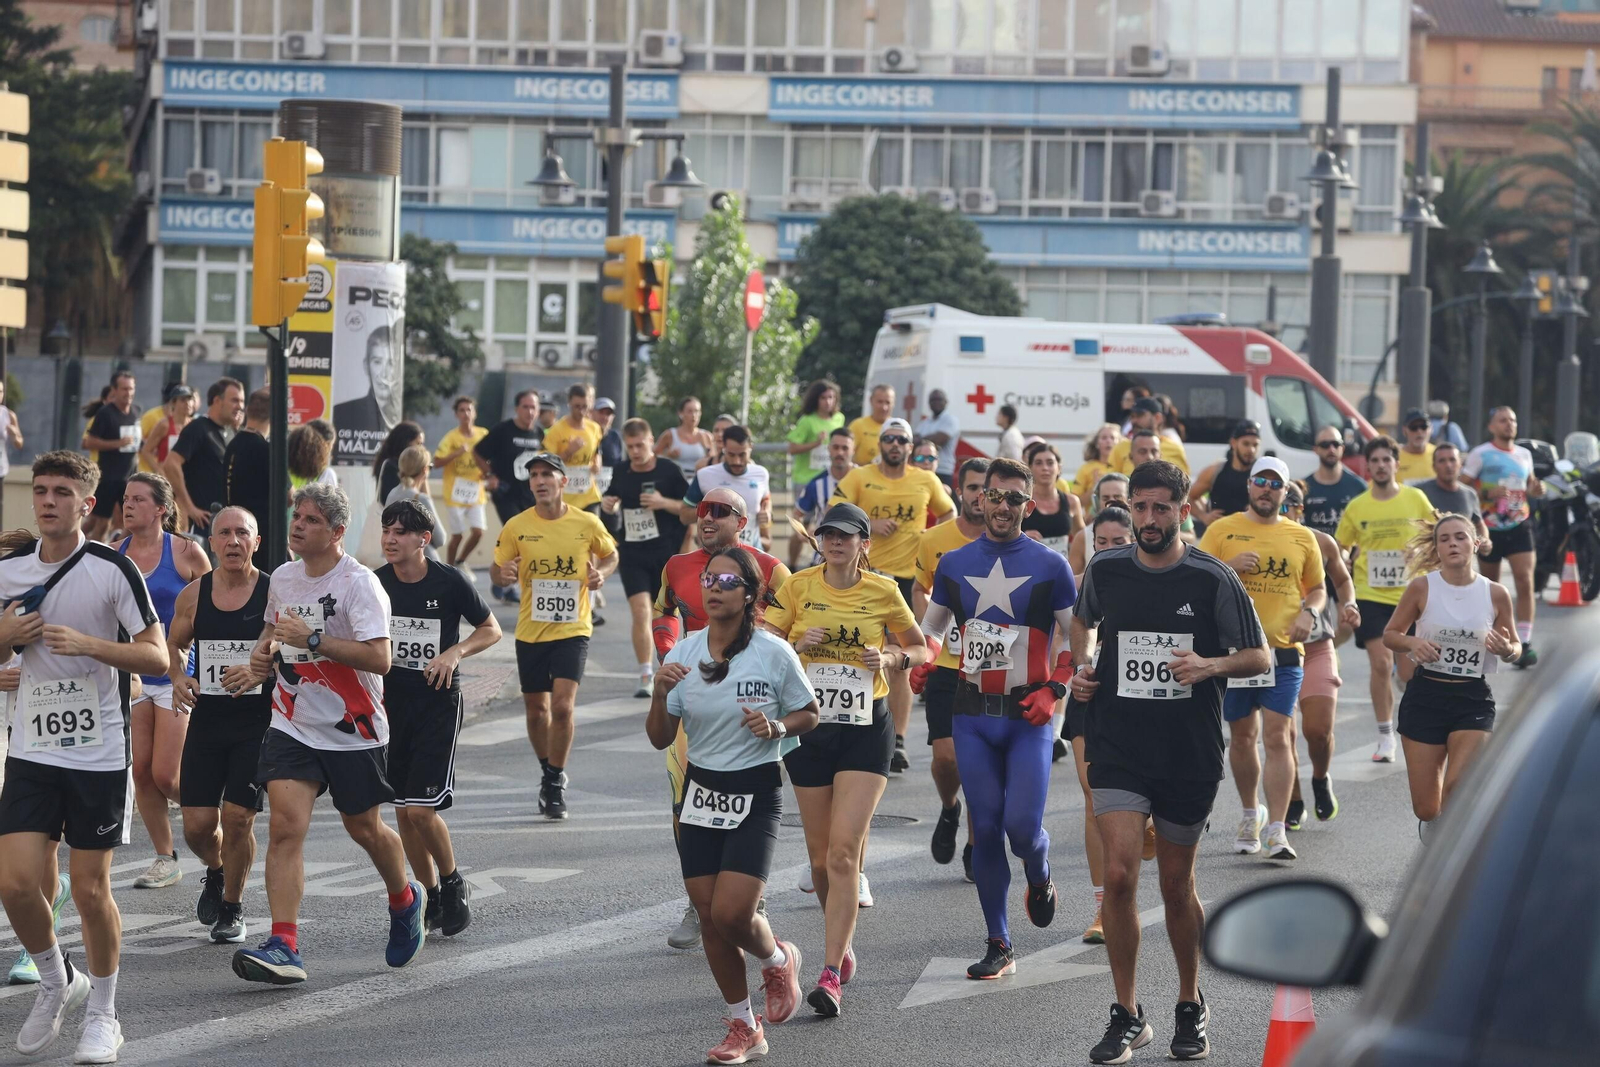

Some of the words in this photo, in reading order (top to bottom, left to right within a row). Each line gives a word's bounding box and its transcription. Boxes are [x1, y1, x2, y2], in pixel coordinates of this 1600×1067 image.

[170, 67, 326, 93] INGECONSER
[514, 77, 670, 101] INGECOSER
[775, 84, 934, 107] INGECONSER
[1128, 89, 1292, 113] INGECONSER
[166, 206, 255, 229] INGECO
[512, 217, 668, 241] INGECOSER
[1137, 229, 1302, 254] INGECONSER
[288, 356, 330, 369] EMBRE
[1004, 391, 1045, 408] Cruz
[1051, 392, 1090, 412] Roja
[627, 518, 655, 531] 11266
[739, 530, 752, 542] 42
[529, 559, 551, 575] 45
[1372, 566, 1405, 579] 1447
[536, 596, 576, 612] 8509
[207, 643, 226, 652] 45
[1129, 635, 1152, 646] 45
[806, 646, 836, 656] ARRERA
[206, 664, 230, 683] 15
[816, 666, 837, 676] 45
[32, 685, 54, 697] 45
[736, 681, 769, 697] LCRC
[32, 708, 95, 736] 1693
[692, 787, 746, 815] 6480
